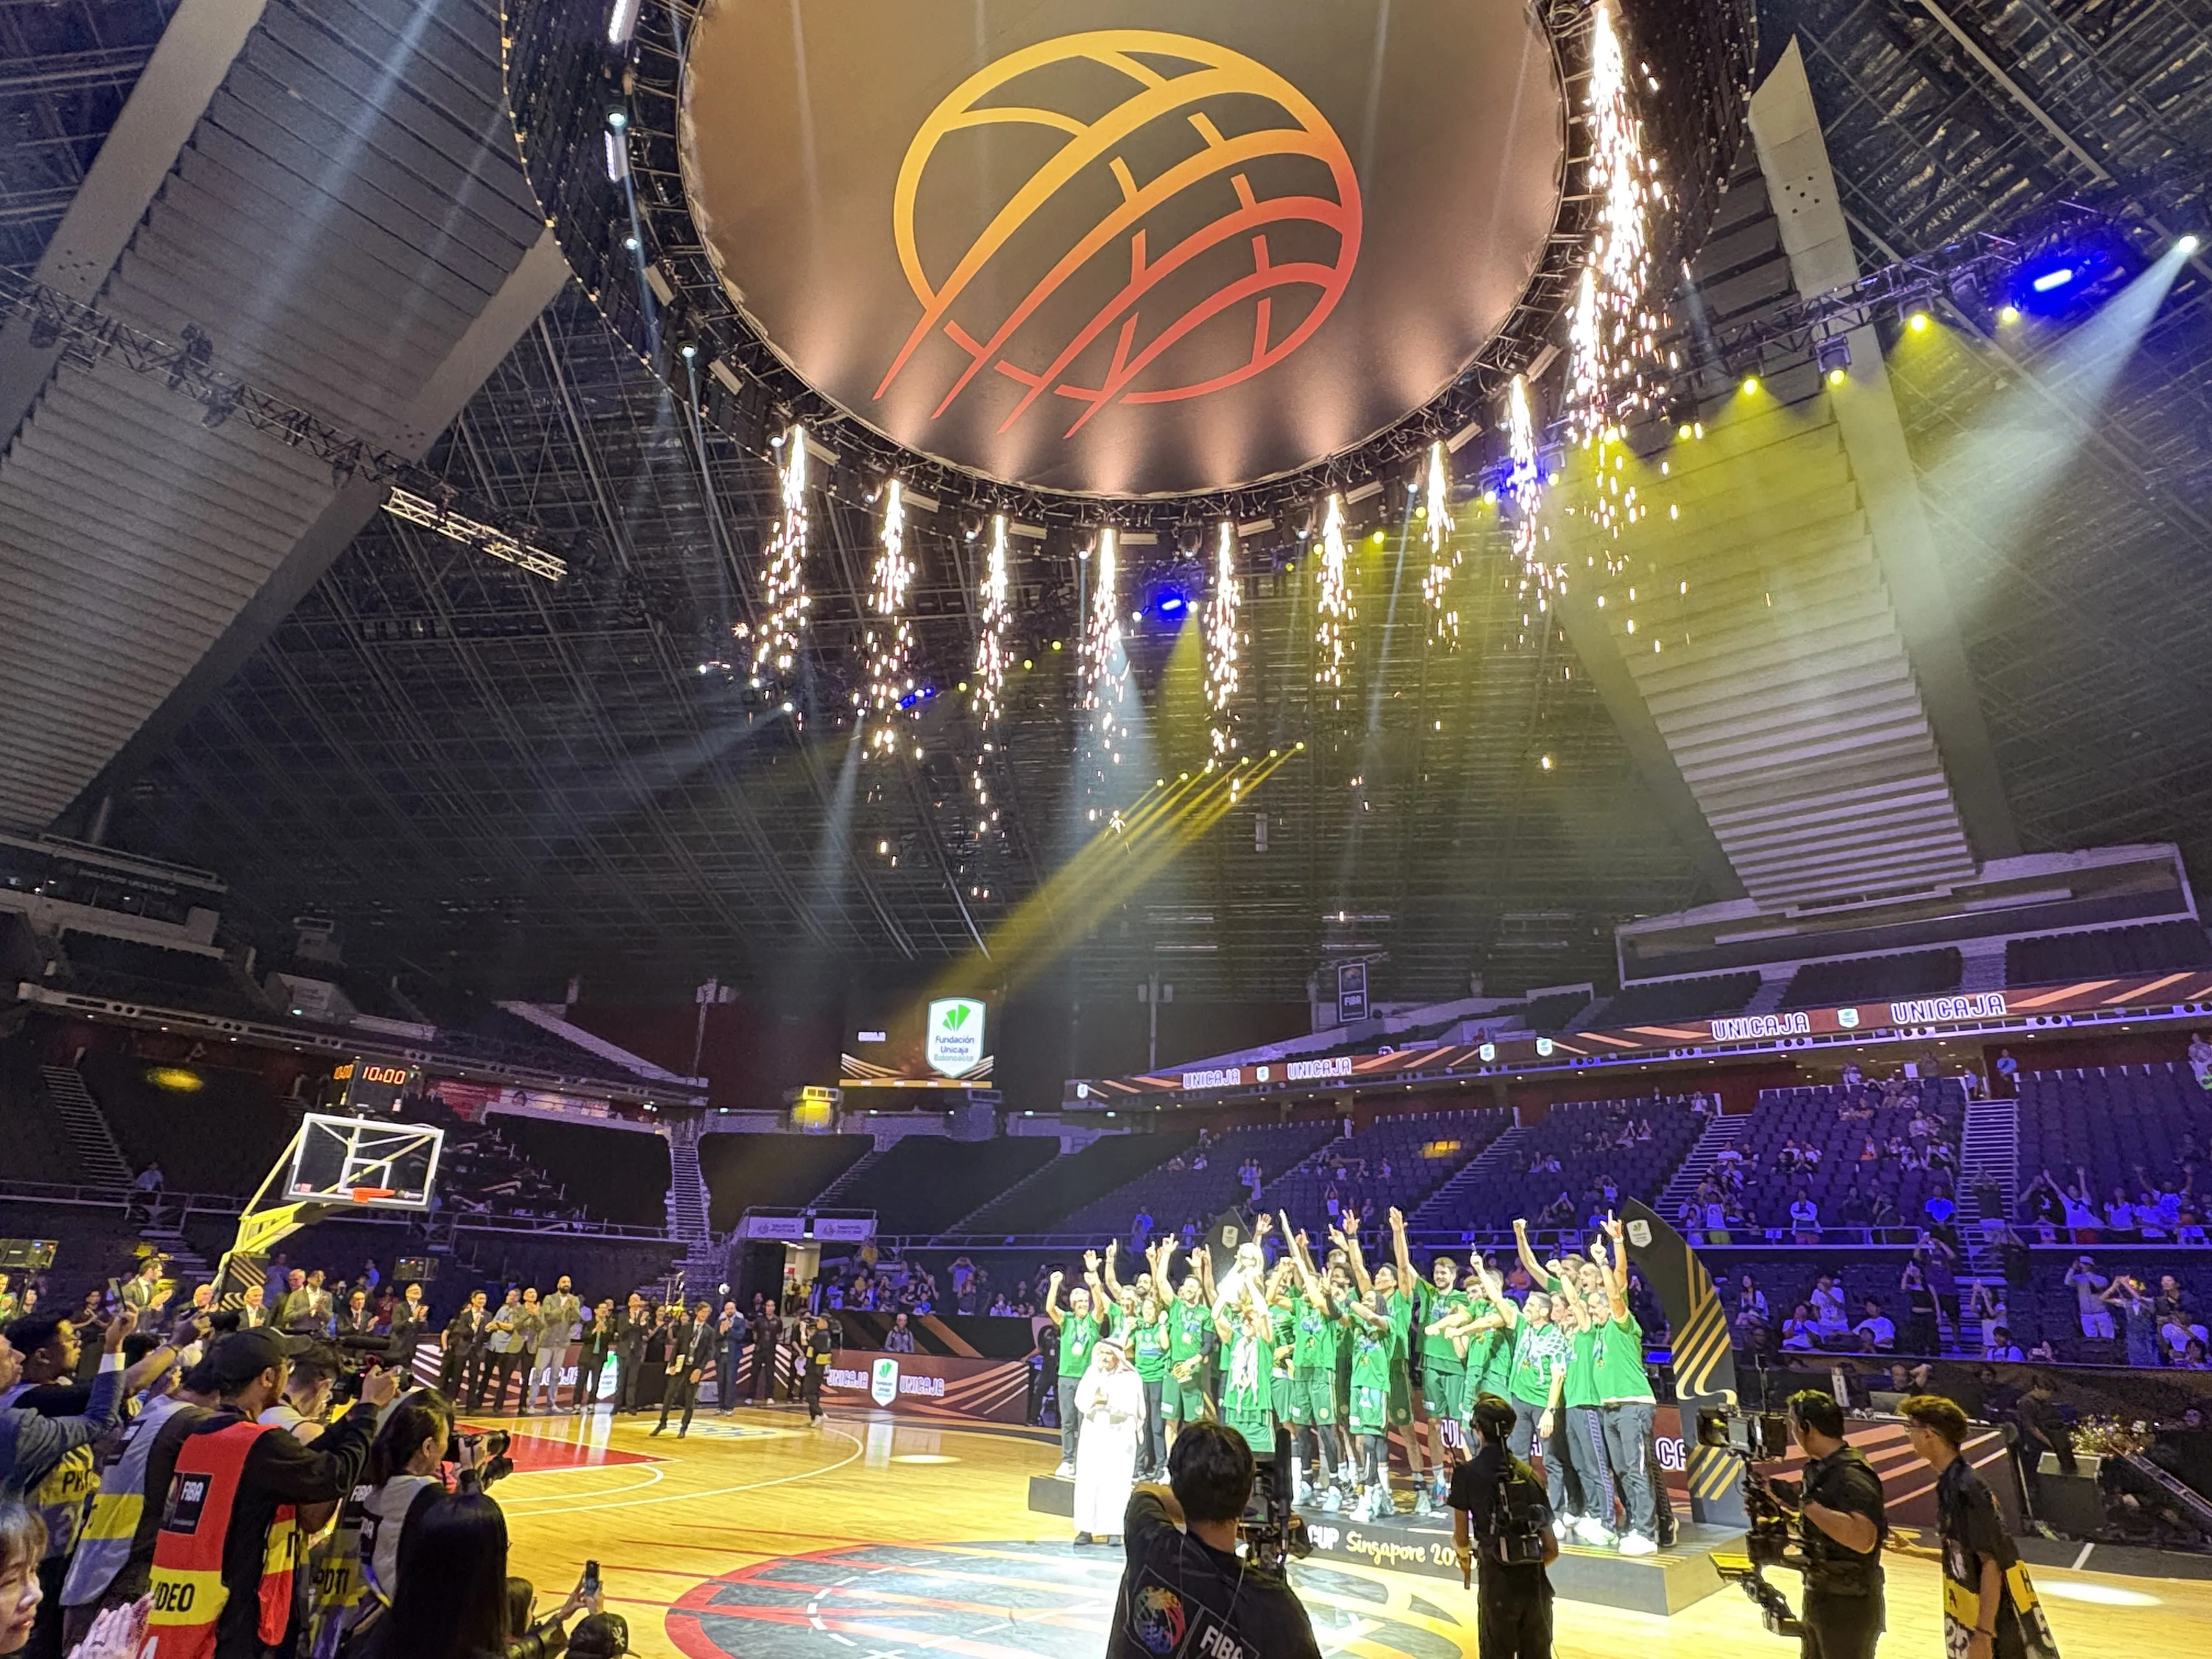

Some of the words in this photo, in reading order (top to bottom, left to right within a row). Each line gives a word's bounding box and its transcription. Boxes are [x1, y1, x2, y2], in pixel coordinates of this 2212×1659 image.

[1889, 993, 2007, 1025] UNICAJA
[1711, 1012, 1810, 1042] UNICAJA
[935, 1035, 974, 1044] Fundación
[940, 1046, 969, 1055] Unicaja
[1183, 1068, 1241, 1090] UNICAJA
[1288, 1057, 1352, 1080] UNICAJA
[899, 1375, 945, 1396] UNICAJA
[1307, 1525, 1340, 1550] CUP
[1346, 1530, 1427, 1566] Singapore
